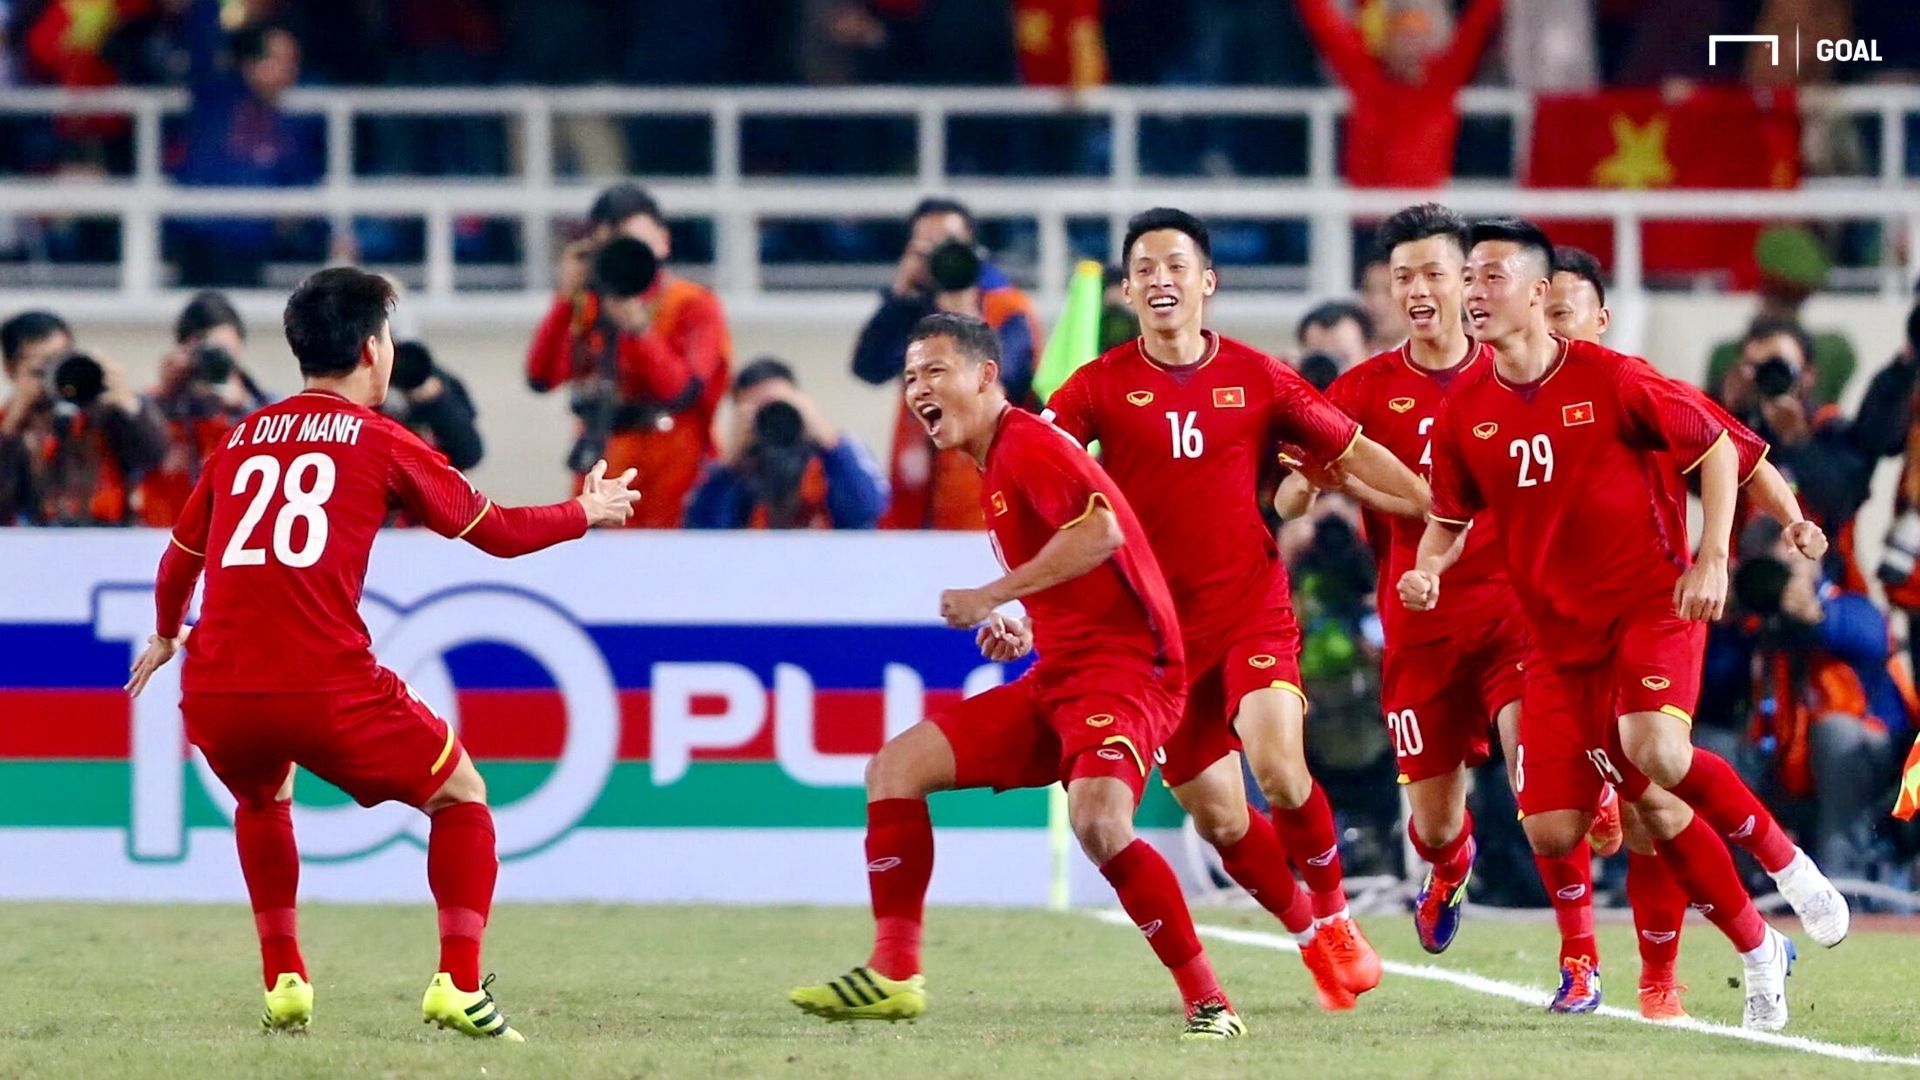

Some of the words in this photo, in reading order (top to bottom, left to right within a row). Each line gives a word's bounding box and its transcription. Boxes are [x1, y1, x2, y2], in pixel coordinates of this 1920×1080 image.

[251, 413, 300, 445] DUY
[295, 412, 363, 446] MANH
[1165, 410, 1204, 459] 16
[1509, 433, 1554, 487] 29
[220, 451, 337, 569] 28
[1387, 708, 1424, 757] 20
